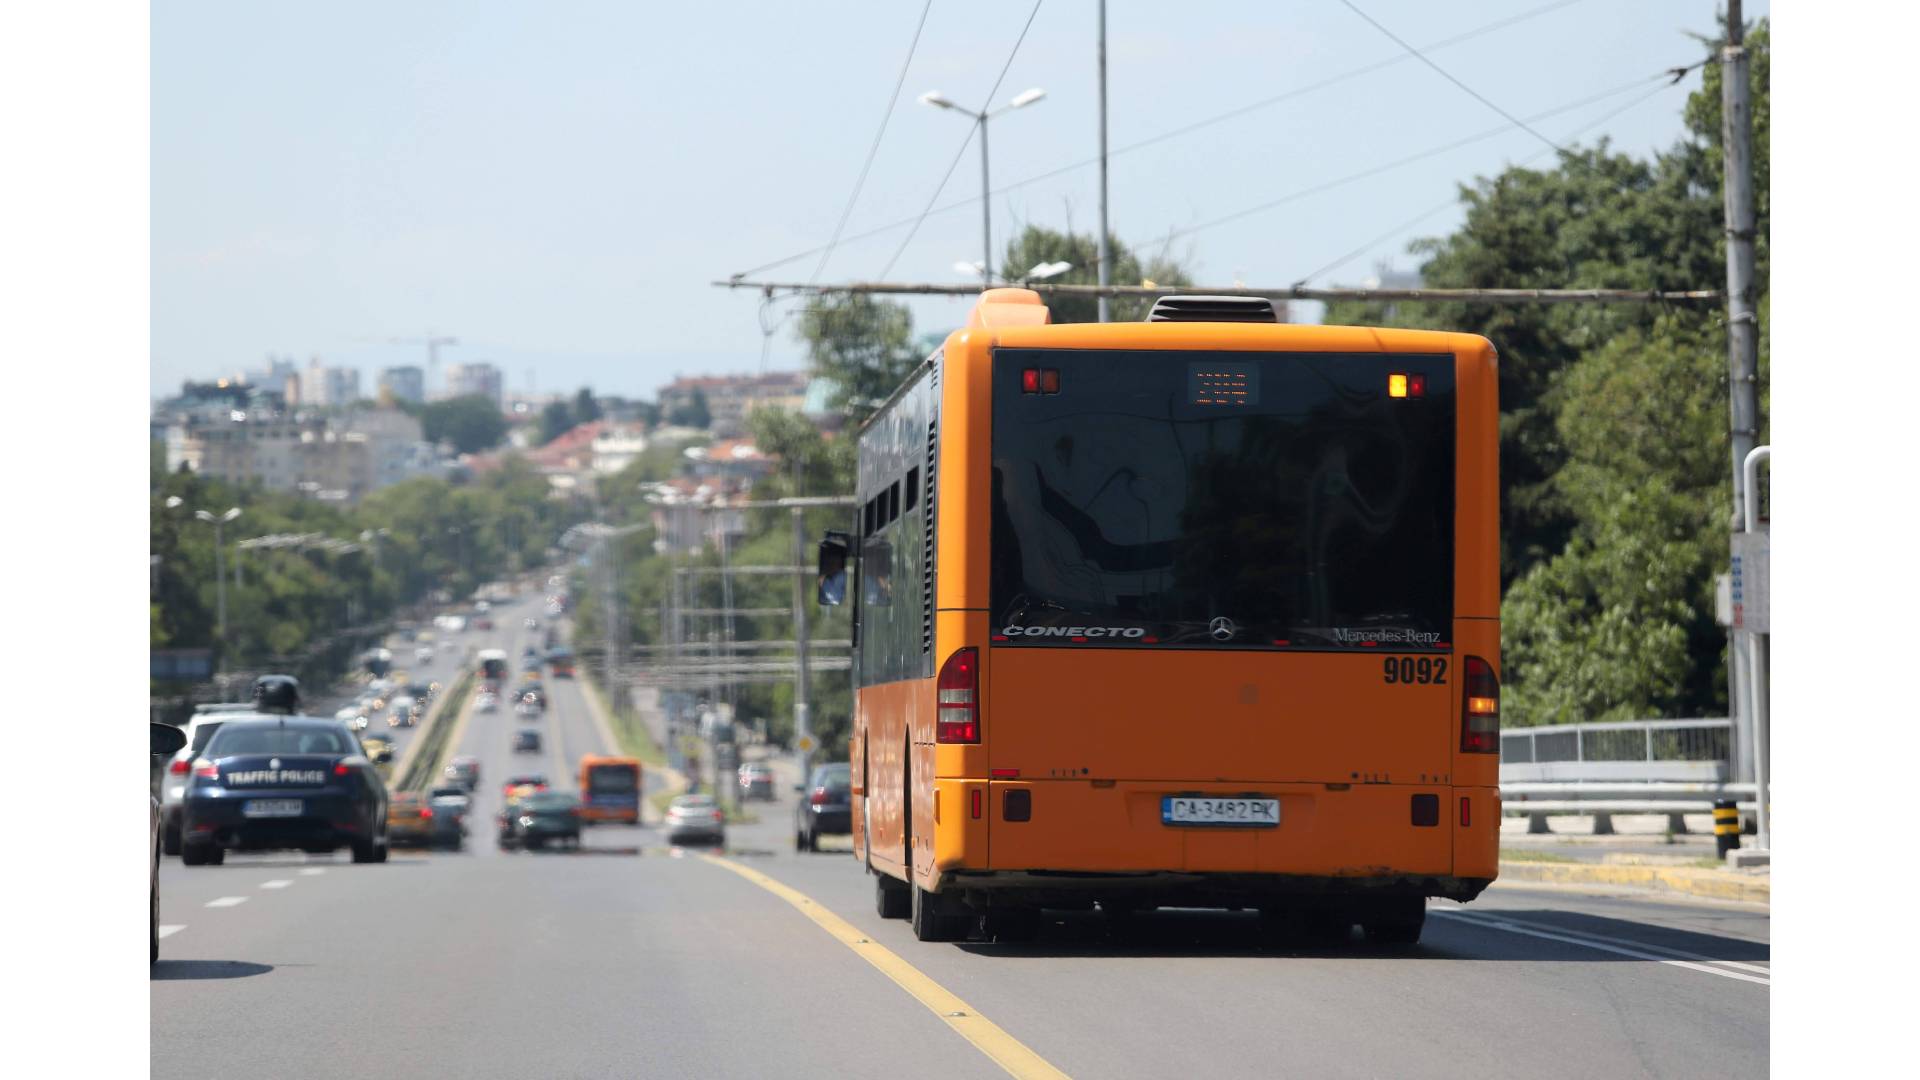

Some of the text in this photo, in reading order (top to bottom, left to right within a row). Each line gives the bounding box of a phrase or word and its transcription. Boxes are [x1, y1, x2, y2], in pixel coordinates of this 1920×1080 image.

[1002, 626, 1145, 637] CONECTO
[1333, 628, 1441, 643] Mercedes-Benz
[1383, 656, 1448, 685] 9092
[227, 770, 325, 785] TRAFFIC POLICE
